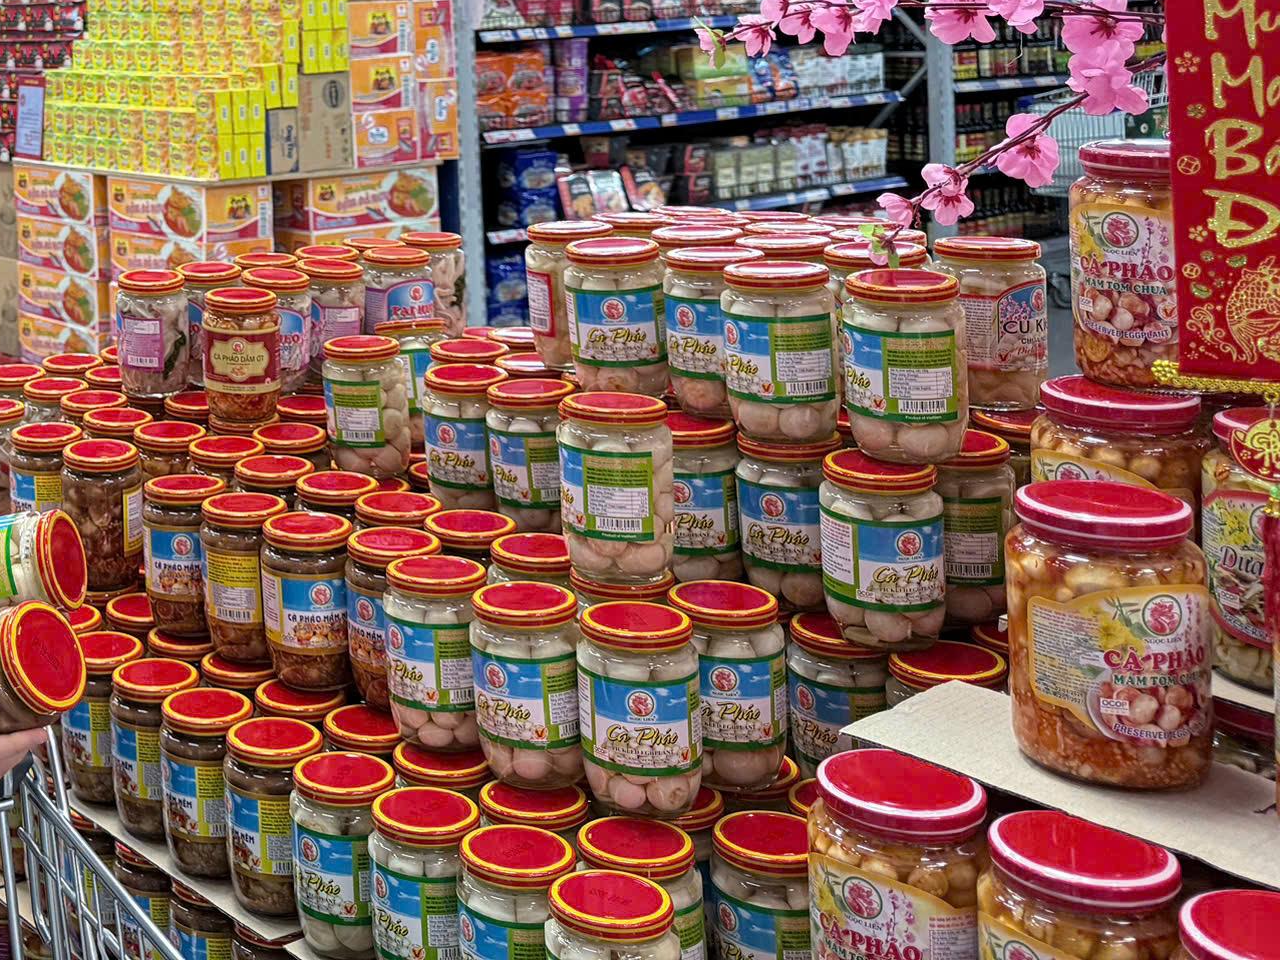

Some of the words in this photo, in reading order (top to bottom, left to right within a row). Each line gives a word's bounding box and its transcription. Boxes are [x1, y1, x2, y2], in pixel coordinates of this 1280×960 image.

[1079, 252, 1102, 277] CÀ
[608, 326, 647, 343] Pháo
[682, 337, 718, 358] Pháo
[443, 448, 476, 470] Pháo
[769, 527, 810, 547] Pháo
[163, 560, 183, 573] PHÁO
[905, 561, 940, 584] Pháo
[298, 611, 321, 623] PHÁO
[1103, 646, 1145, 672] CÀ
[1151, 644, 1206, 672] PHÁO
[491, 696, 532, 722] Pháo
[716, 700, 761, 722] Pháo
[634, 723, 679, 747] Pháo
[819, 911, 844, 945] CÀ
